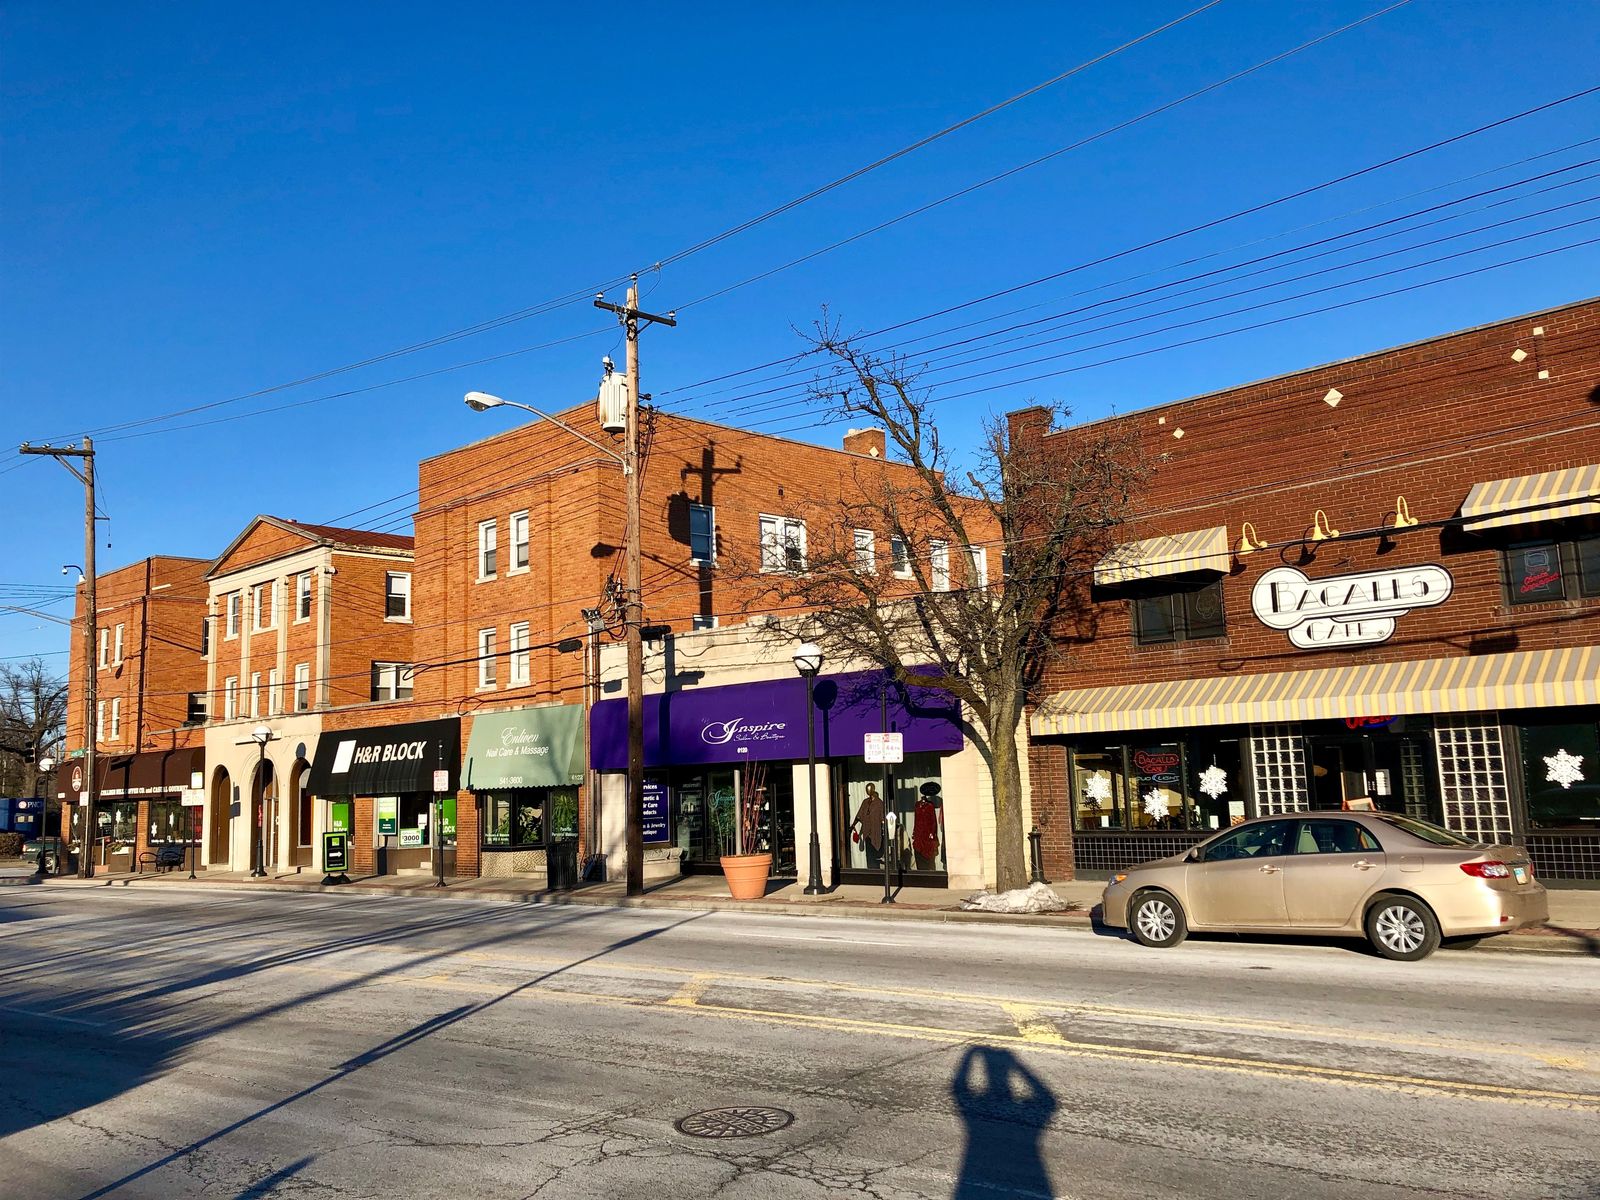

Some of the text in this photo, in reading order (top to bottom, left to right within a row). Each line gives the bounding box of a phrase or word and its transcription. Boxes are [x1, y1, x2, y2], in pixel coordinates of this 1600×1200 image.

[1270, 574, 1429, 613] BACALLS
[1306, 621, 1369, 641] CAFE
[501, 726, 540, 746] Enliven
[701, 717, 786, 745] Inspire
[353, 741, 427, 764] H&R BLOCK
[485, 745, 550, 758] Nail Care & Massage
